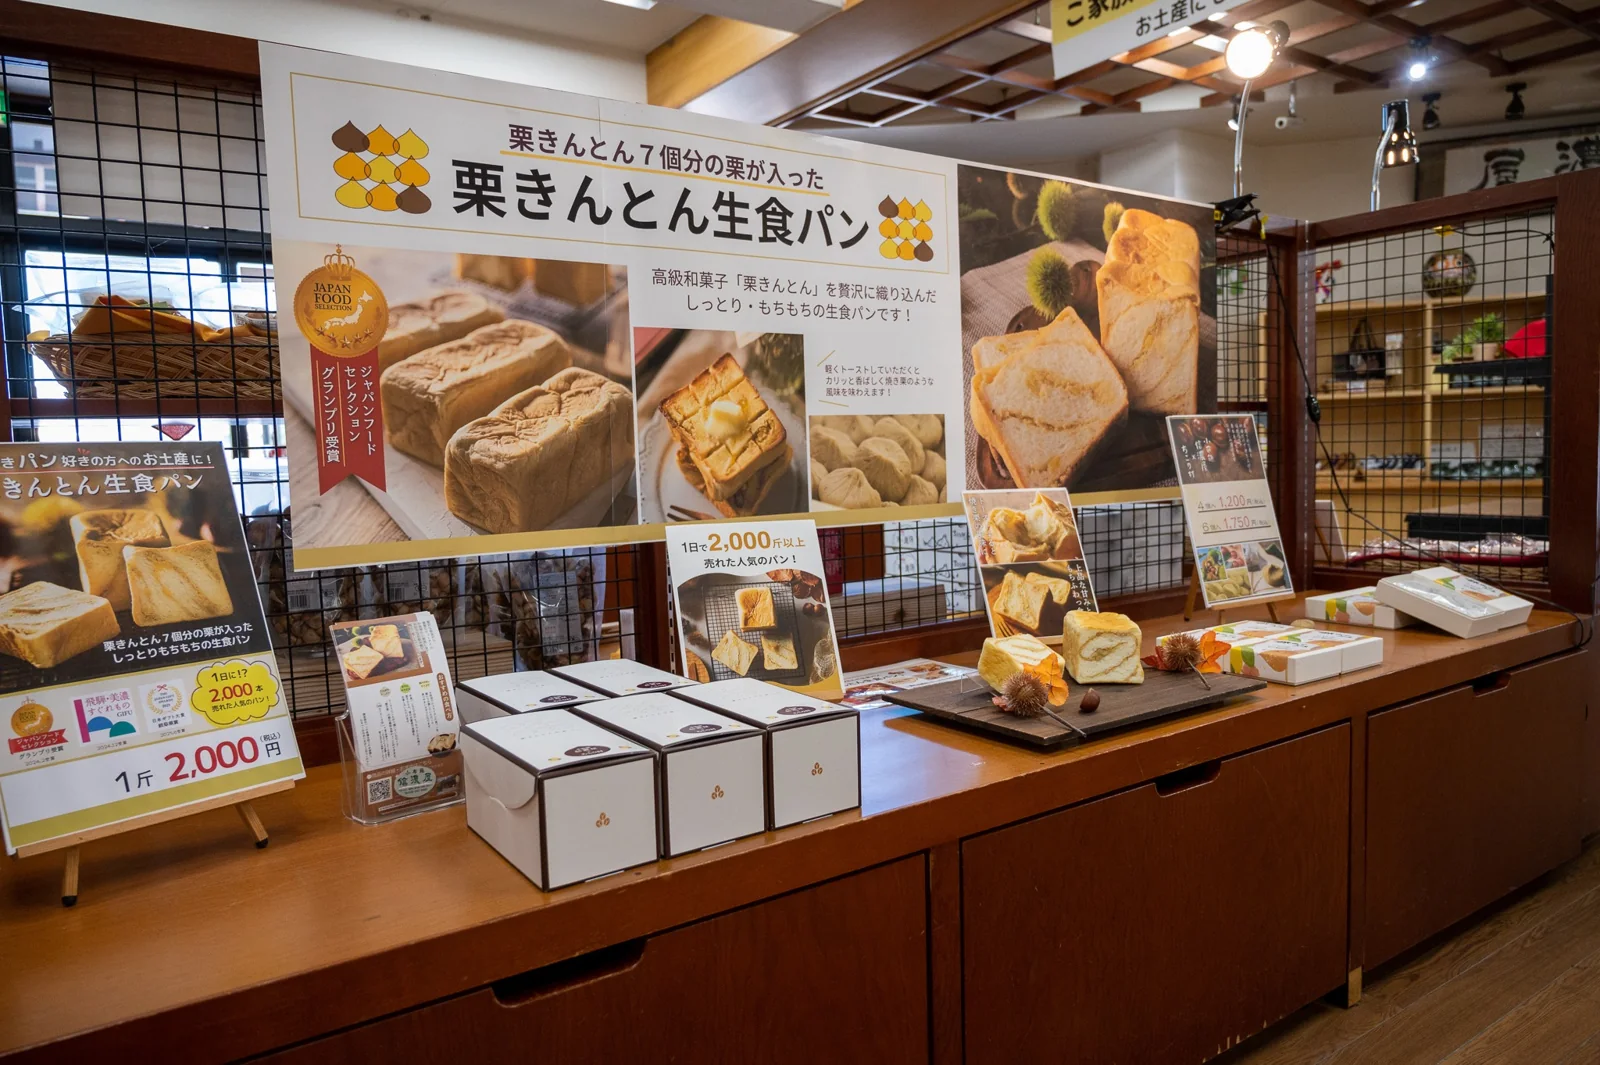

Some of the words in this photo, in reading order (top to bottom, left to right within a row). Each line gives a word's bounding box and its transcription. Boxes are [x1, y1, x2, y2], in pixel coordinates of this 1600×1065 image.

[508, 122, 824, 191] 栗きんとん7個分の栗が入った
[451, 157, 869, 250] 栗きんとん生食パン
[314, 282, 352, 294] JAPAN
[651, 267, 937, 304] 高級和菓子「栗きんとん」を贅沢に織り込んだ
[314, 293, 352, 305] FOOD
[314, 303, 353, 311] SELECTION
[686, 294, 912, 322] しっとり・もちもちの生食パンです！
[824, 364, 921, 375] 軽くトーストしていただくと
[825, 375, 934, 387] カリッと香ばしく焼き栗のような
[825, 387, 892, 397] 風味を味わえます！
[344, 365, 361, 442] セレクション
[360, 365, 376, 456] ジャパンフード
[322, 366, 341, 464] グランプリ受賞
[3, 473, 203, 499] きんとん生食パン
[681, 531, 806, 553] 1日で2,000斤以上
[703, 555, 797, 569] 売れた人気のパン！
[103, 622, 254, 652] 栗きんとん7個分の栗が入った
[113, 634, 251, 664] しっとりもちもちの生食パン
[85, 690, 130, 707] 飛騨・美濃
[212, 695, 270, 713] 売れた人気のパン！
[438, 673, 453, 720] おすすめの食べ方
[87, 702, 131, 716] すぐれもの
[16, 731, 61, 745] ジャパンフード
[21, 738, 58, 750] セレクション
[115, 769, 154, 793] 1斤
